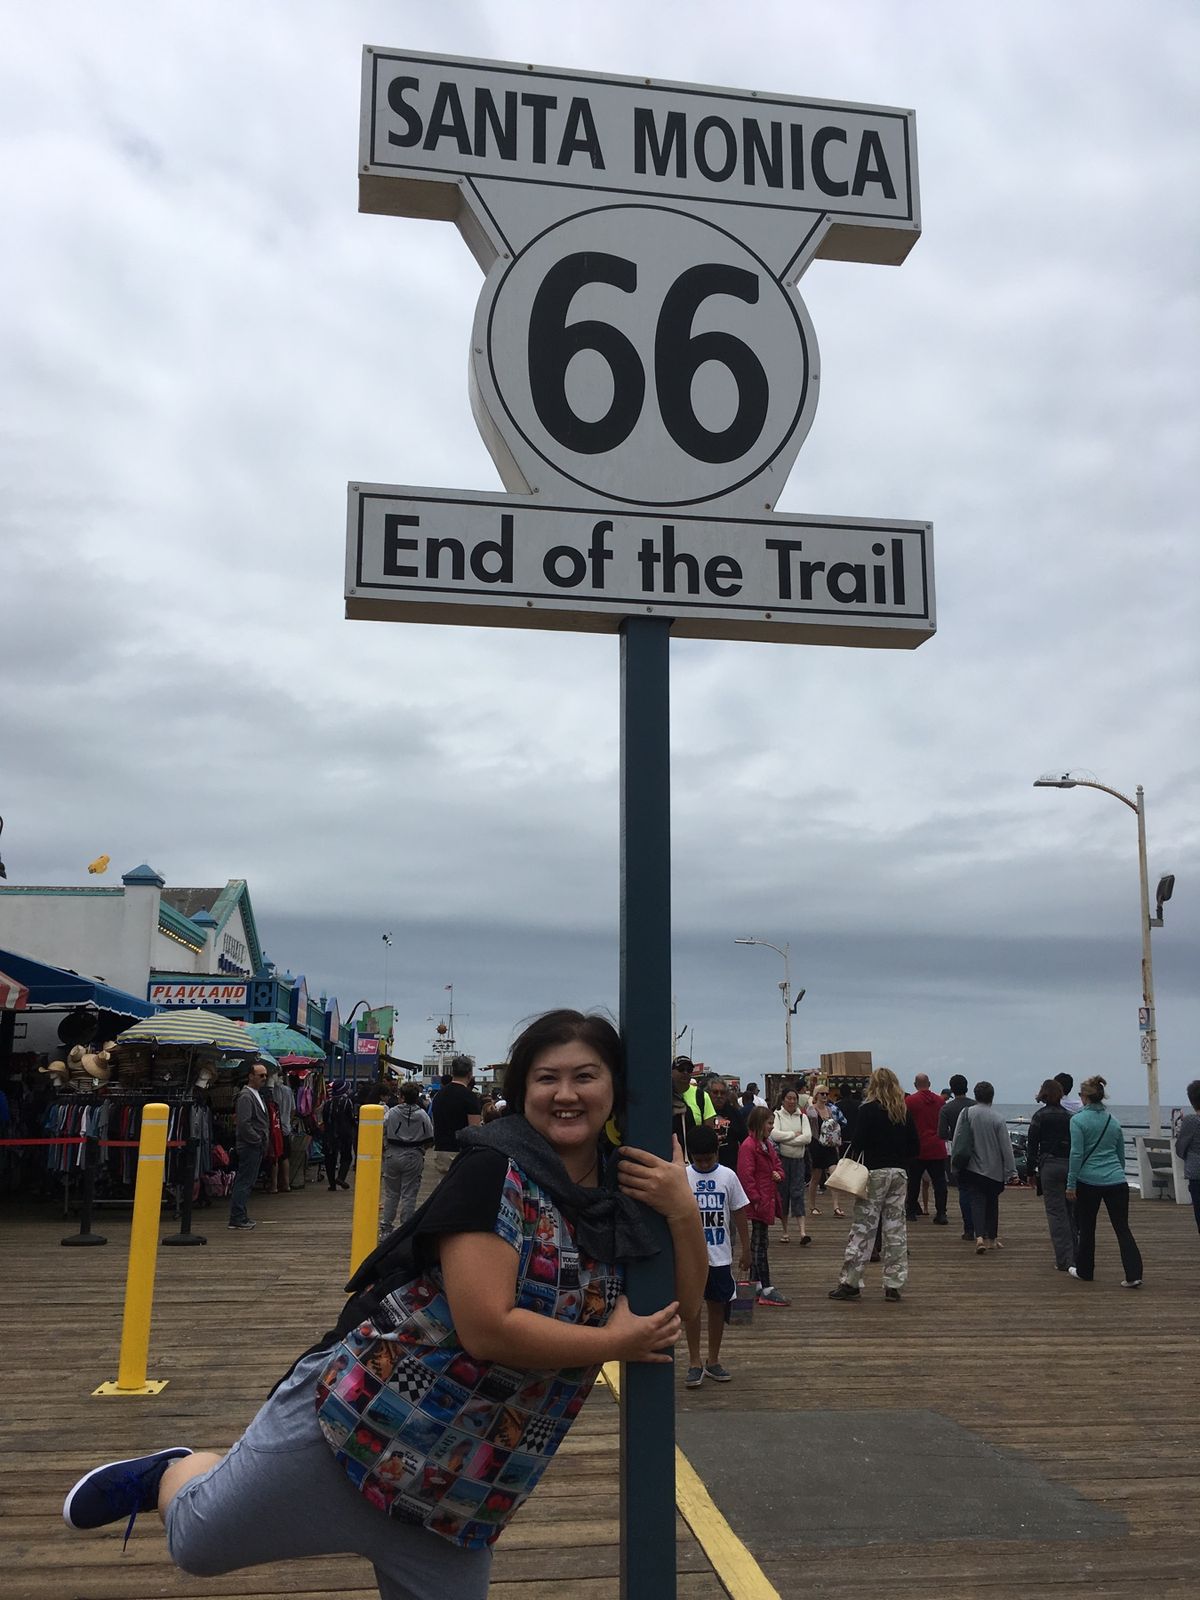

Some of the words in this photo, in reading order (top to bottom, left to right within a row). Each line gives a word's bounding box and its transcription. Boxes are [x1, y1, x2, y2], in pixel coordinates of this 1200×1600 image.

[387, 76, 606, 171] SANTA
[633, 107, 897, 200] MONICA
[527, 251, 770, 464] 66
[383, 513, 514, 583] End
[542, 520, 613, 589] of
[637, 525, 743, 597] the
[765, 538, 906, 606] Trail
[152, 986, 245, 998] PLAYLAND
[696, 1180, 716, 1191] SO
[697, 1194, 724, 1208] OOL
[704, 1227, 725, 1245] AD
